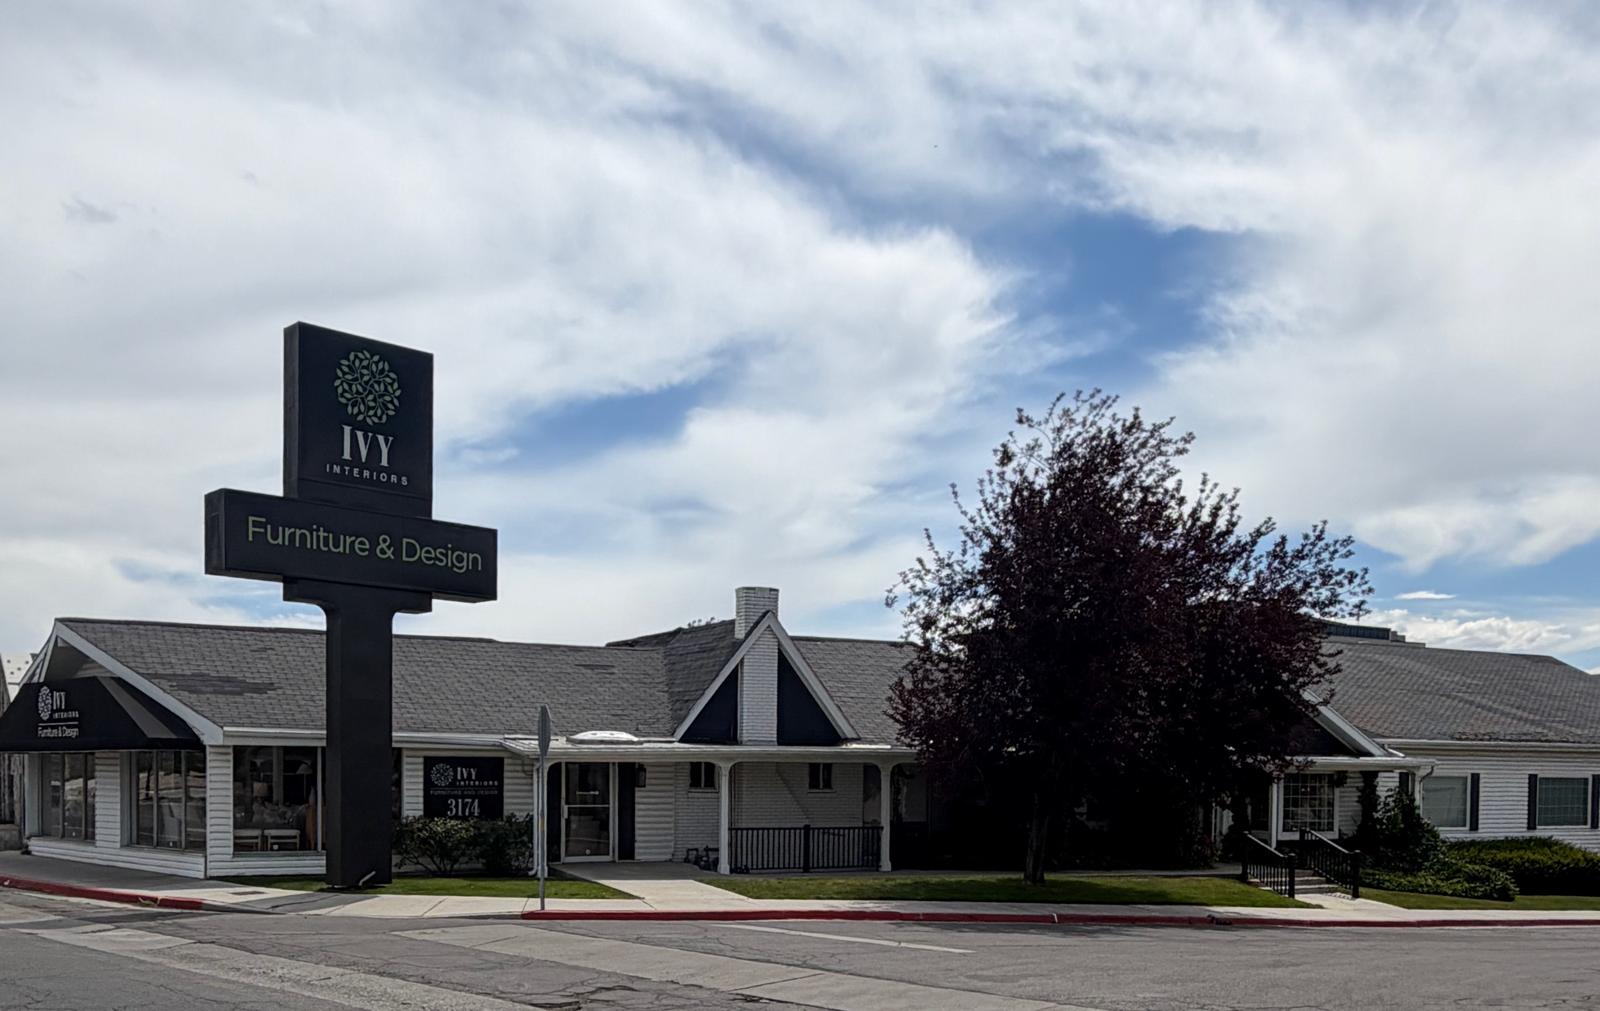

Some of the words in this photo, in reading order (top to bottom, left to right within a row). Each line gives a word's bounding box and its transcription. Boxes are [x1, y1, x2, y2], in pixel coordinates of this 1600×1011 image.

[341, 424, 394, 467] IVY
[326, 463, 408, 486] INTERIORS
[248, 515, 370, 556] Furniture
[376, 534, 395, 560] &
[402, 537, 482, 573] Design
[457, 766, 478, 780] IVY
[447, 798, 480, 817] 3174
